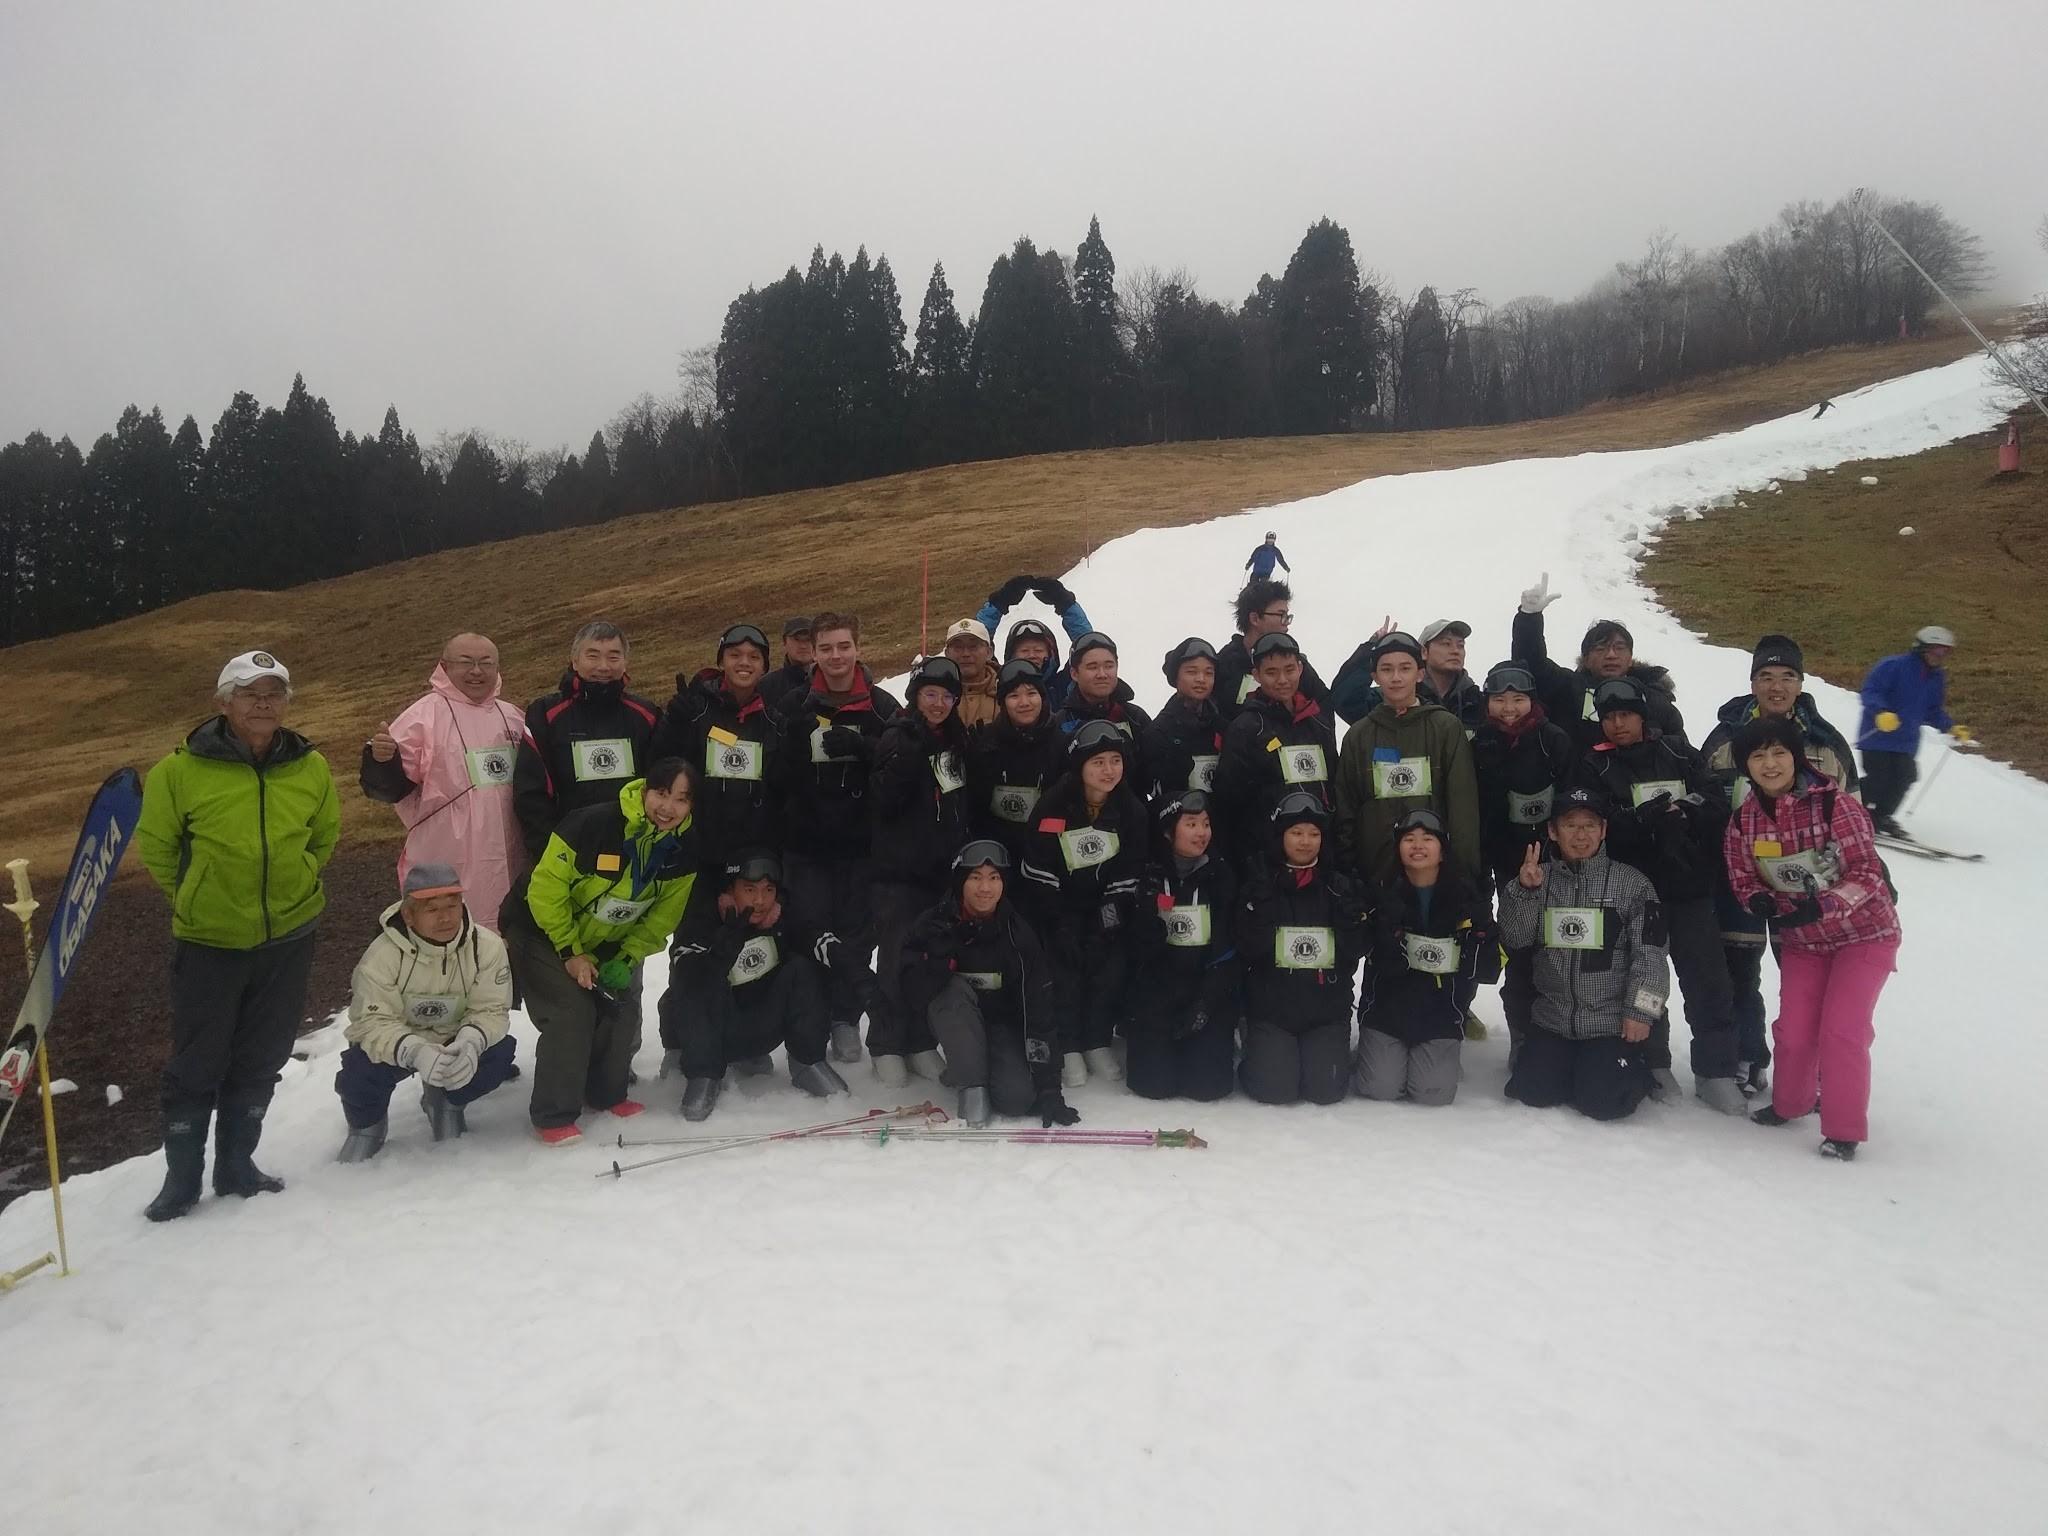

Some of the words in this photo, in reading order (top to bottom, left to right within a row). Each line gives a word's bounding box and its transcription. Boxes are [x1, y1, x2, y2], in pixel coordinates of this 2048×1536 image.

[600, 756, 608, 766] L
[731, 755, 739, 765] L
[1302, 760, 1310, 769] L
[1398, 774, 1406, 784] L
[1087, 843, 1096, 853] L
[58, 815, 122, 978] OGASAKA
[1177, 922, 1185, 932] L
[1569, 924, 1577, 934] L
[1302, 943, 1310, 954] L
[1427, 951, 1435, 960] L
[749, 957, 758, 966] L
